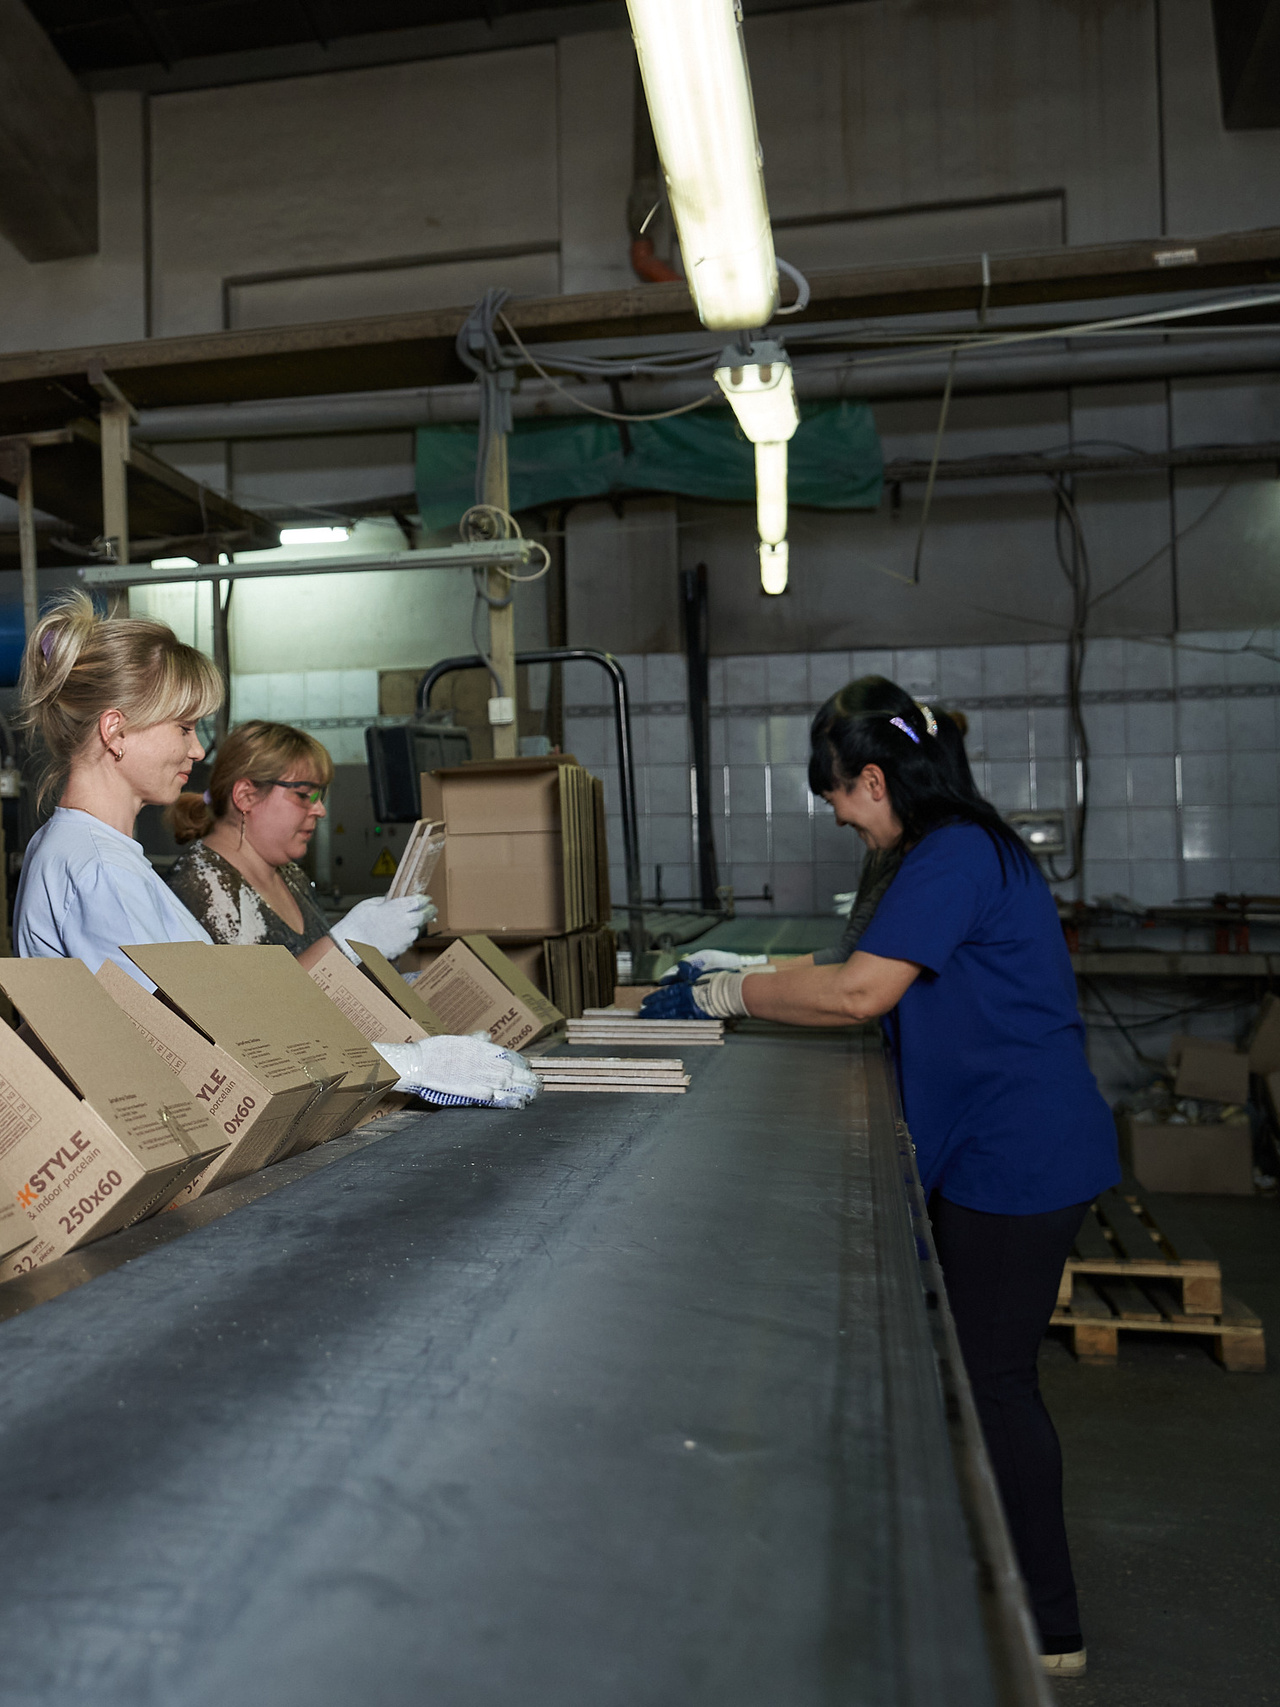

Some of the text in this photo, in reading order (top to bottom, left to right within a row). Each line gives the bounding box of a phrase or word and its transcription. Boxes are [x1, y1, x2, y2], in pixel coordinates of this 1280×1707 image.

[208, 1079, 237, 1116] porcelain
[35, 1186, 64, 1217] indoor
[61, 1146, 102, 1190] porcelain
[58, 1169, 123, 1235] 250x60
[37, 1244, 56, 1262] pieces
